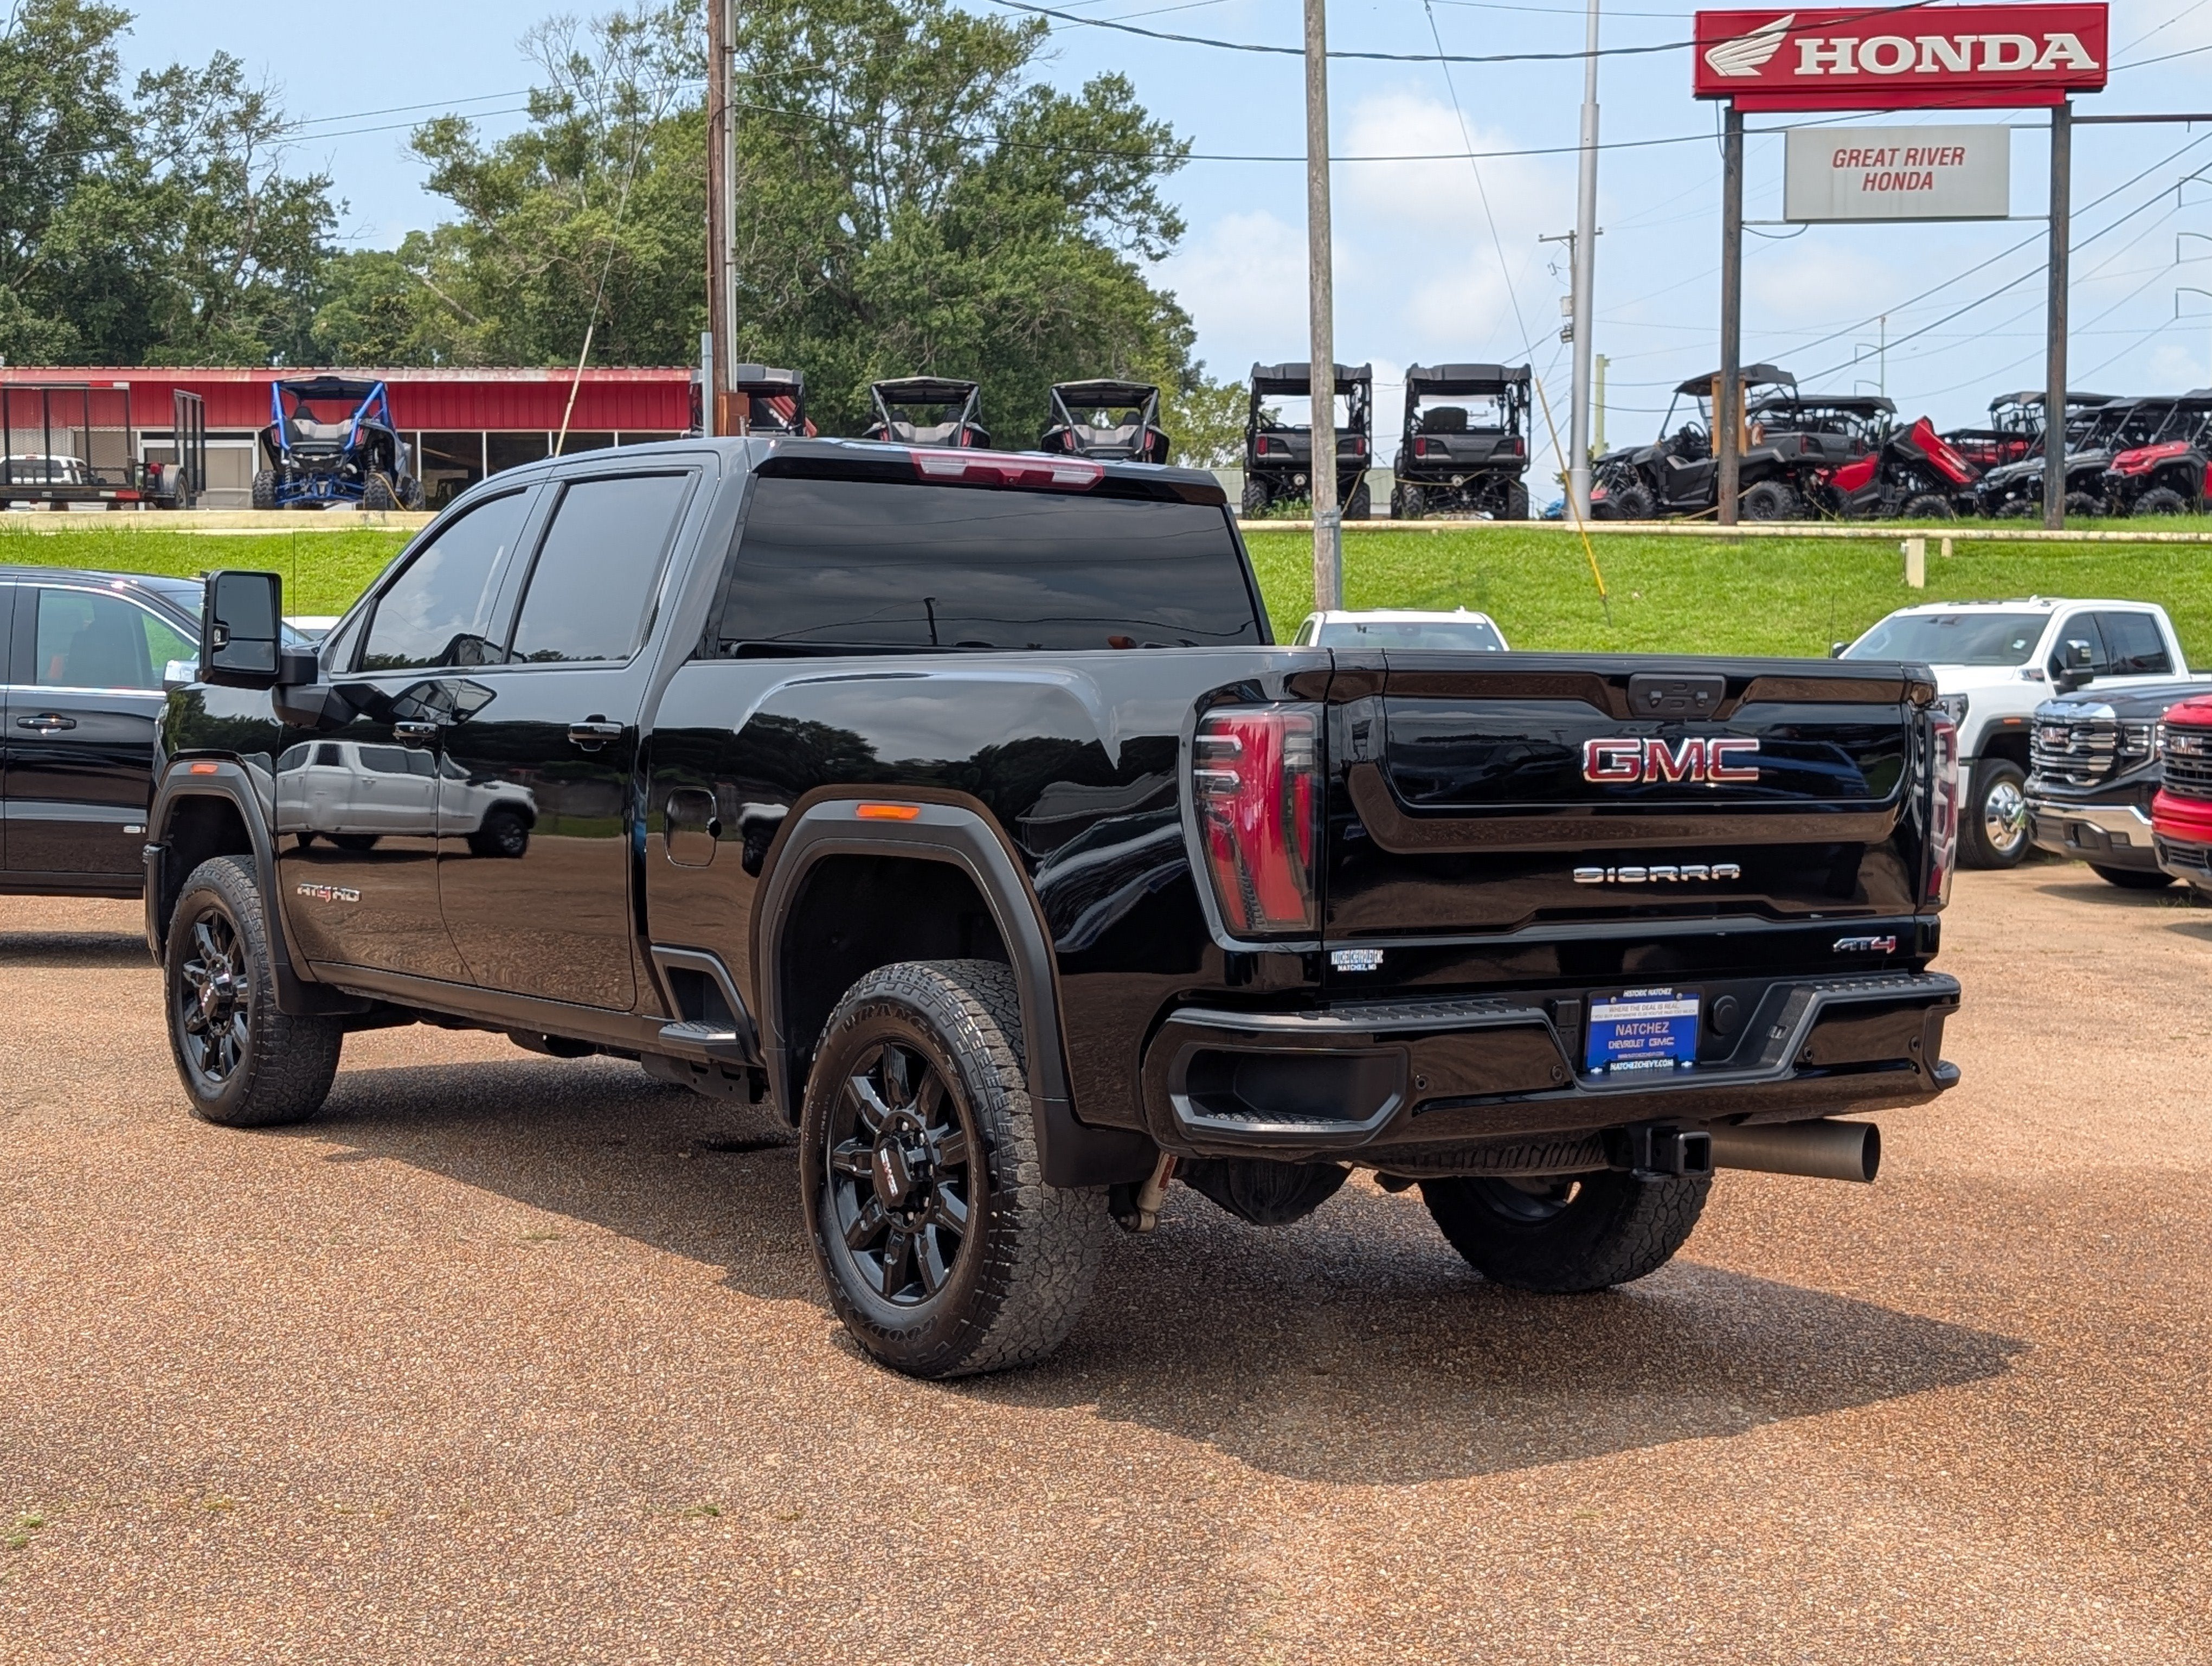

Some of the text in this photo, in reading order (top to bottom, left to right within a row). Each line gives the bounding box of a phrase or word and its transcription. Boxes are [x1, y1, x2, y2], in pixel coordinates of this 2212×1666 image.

[1793, 33, 2099, 75] HONDA
[1832, 146, 1965, 169] GREAT RIVER
[1861, 171, 1933, 192] HONDA
[1583, 738, 1759, 783] GMC
[1573, 863, 1741, 883] SIERRA
[1615, 1022, 1670, 1036] NATCHEZ
[1608, 1036, 1675, 1049] CHEVROLET GMC
